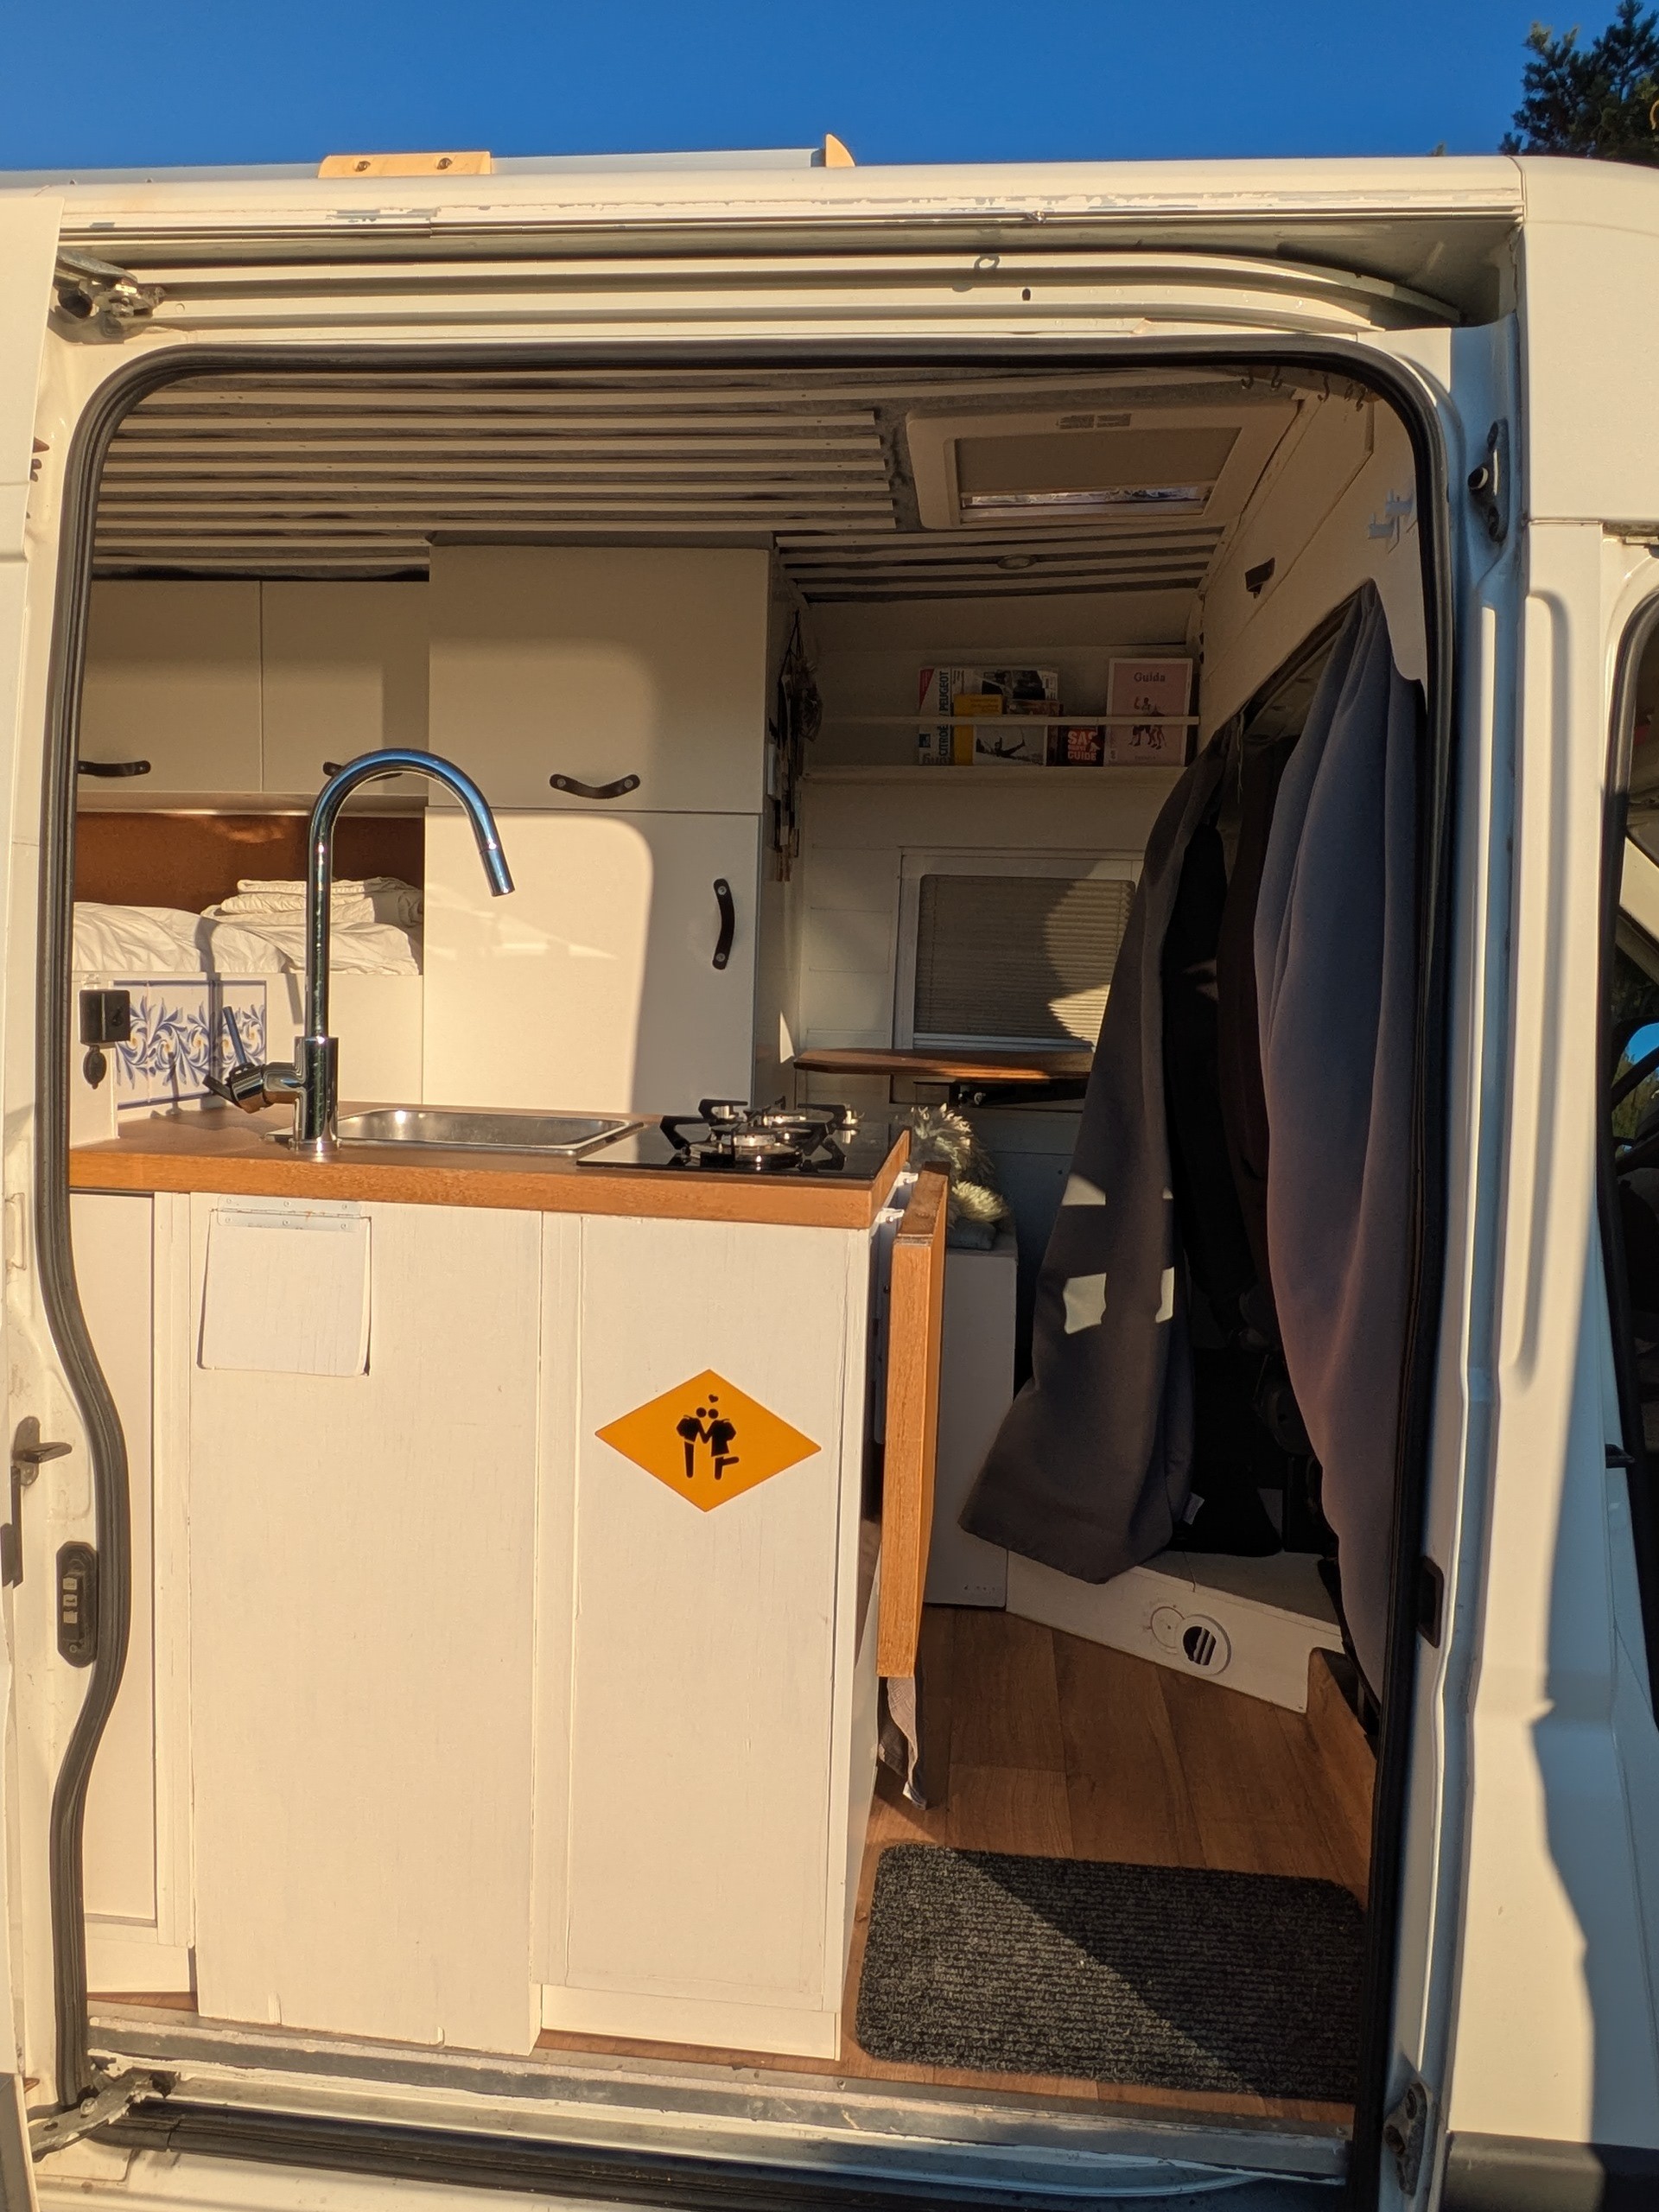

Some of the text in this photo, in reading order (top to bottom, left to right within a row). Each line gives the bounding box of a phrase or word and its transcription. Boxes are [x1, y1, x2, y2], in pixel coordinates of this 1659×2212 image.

[1134, 672, 1166, 683] Guida
[938, 671, 949, 712] PEUGEOT
[938, 723, 949, 757] CITROË
[1067, 751, 1097, 760] GUIDE
